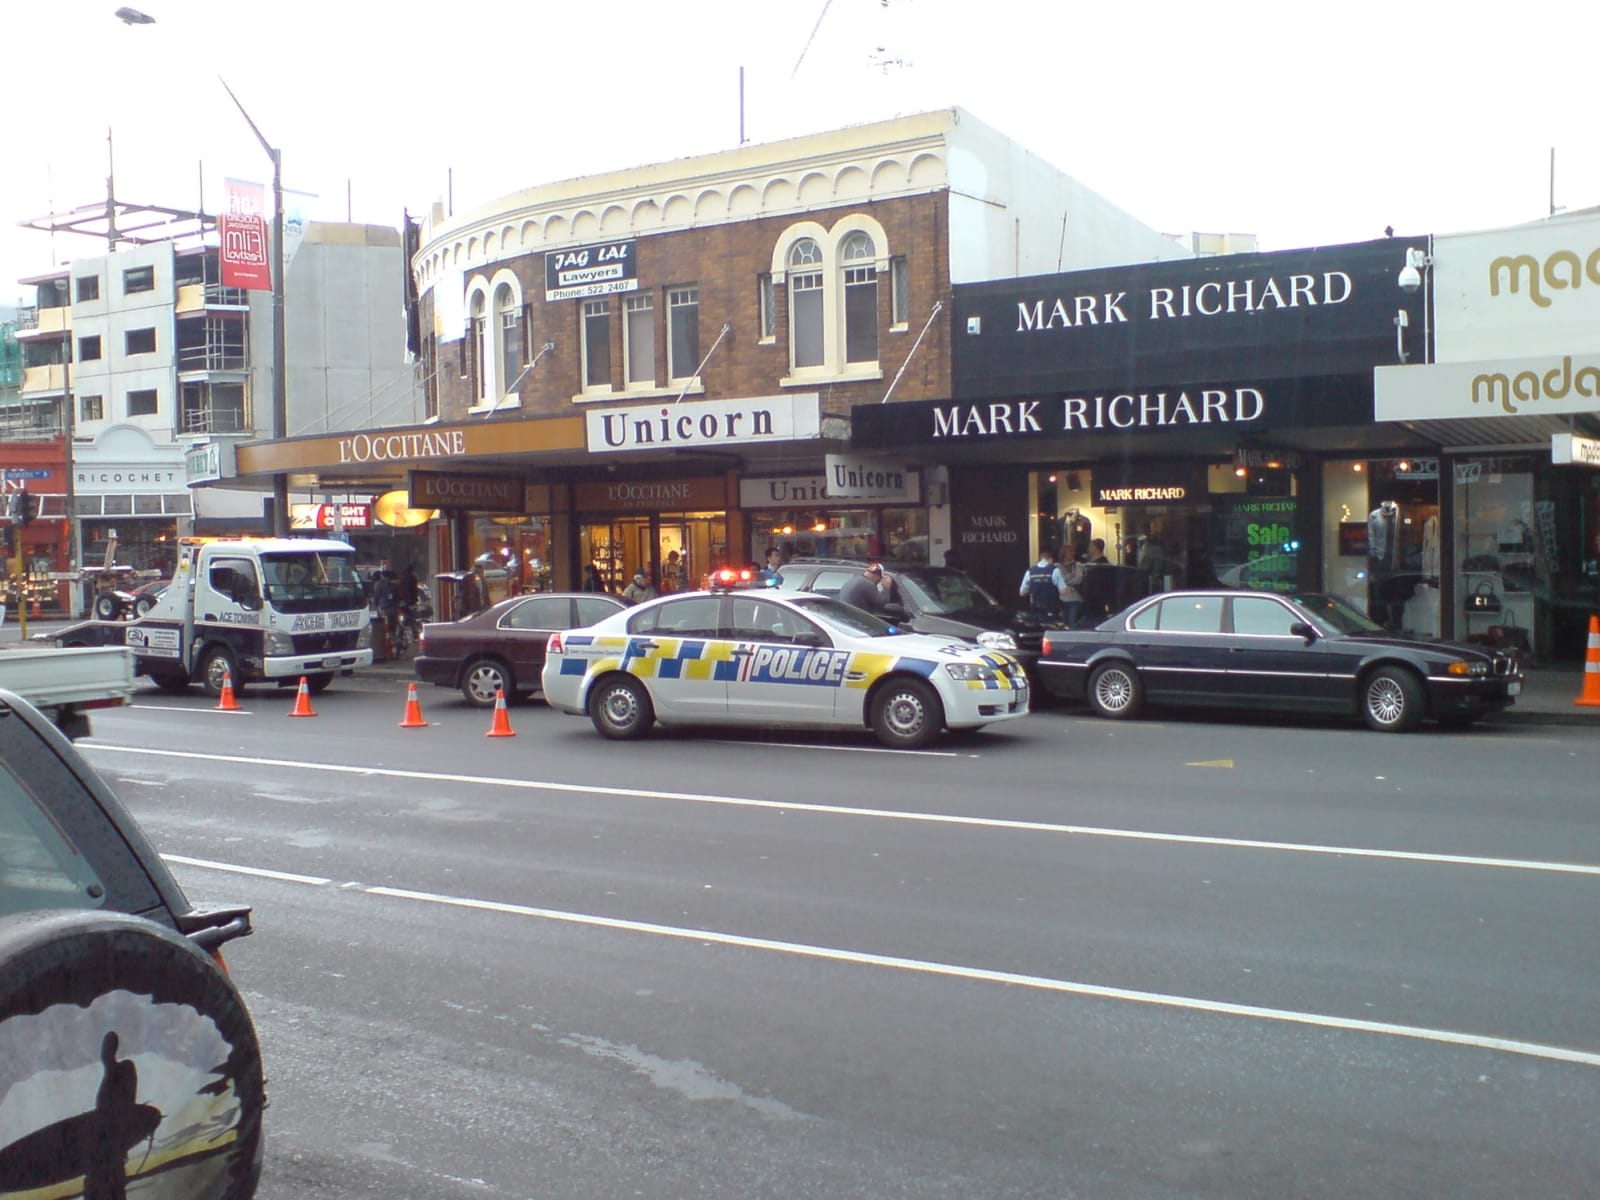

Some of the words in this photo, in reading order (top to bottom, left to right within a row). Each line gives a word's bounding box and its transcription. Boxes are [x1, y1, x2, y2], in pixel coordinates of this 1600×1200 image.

[555, 250, 589, 270] JAG
[598, 244, 627, 262] LAL
[563, 267, 618, 281] Lawyers
[553, 289, 585, 299] Phone:
[587, 285, 604, 295] 522
[608, 281, 629, 292] 2407
[1016, 291, 1127, 332] MARK
[1149, 271, 1352, 320] RICHARD
[932, 401, 1042, 437] MARK
[1063, 388, 1264, 430] RICHARD
[601, 408, 774, 448] Unicorn
[339, 429, 466, 463] L'OCCITANE
[78, 473, 174, 482] RICOCHET
[834, 465, 904, 489] Unicorn
[425, 478, 511, 497] L'OCCITANE
[607, 482, 690, 500] L'OCCITANE
[1099, 488, 1132, 500] MARK
[1134, 487, 1185, 499] RICHARD
[324, 506, 365, 516] FLGHT
[970, 515, 1007, 527] MARK
[962, 531, 1017, 544] RICHARD
[1247, 523, 1290, 546] Sale
[1247, 549, 1290, 572] Sale
[219, 612, 233, 622] ACE
[291, 614, 325, 631] ACE
[751, 648, 848, 681] POLICE
